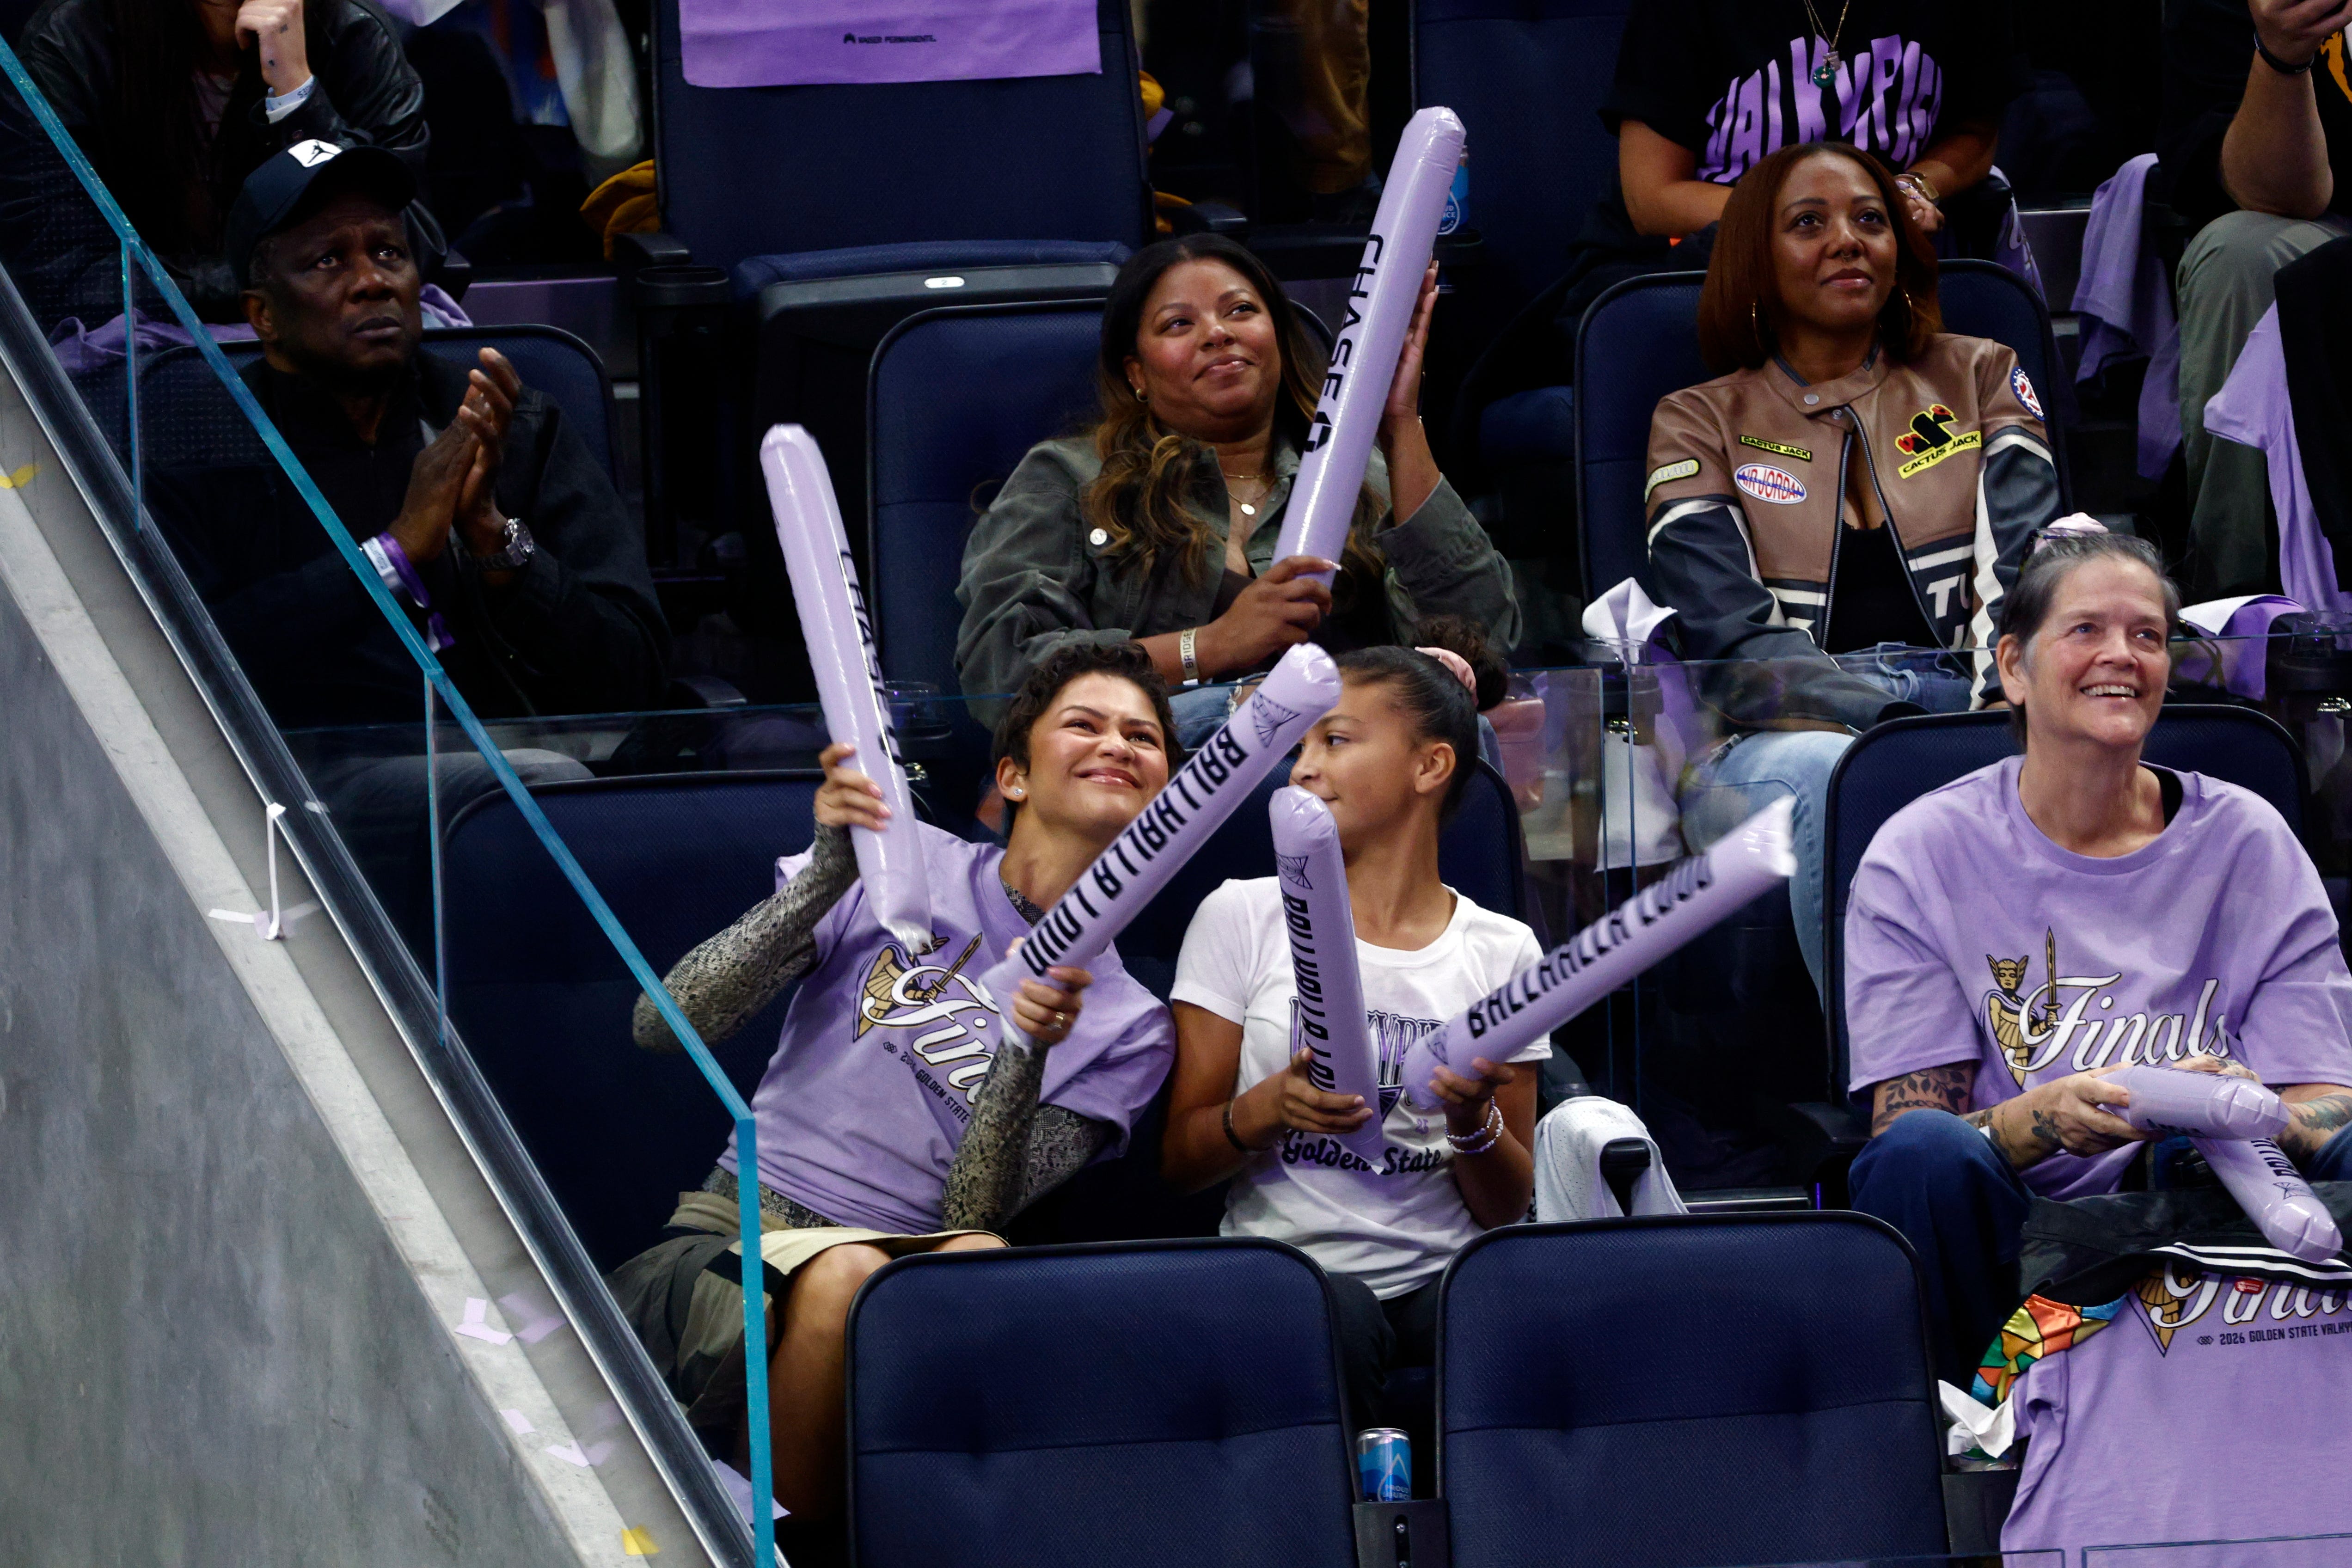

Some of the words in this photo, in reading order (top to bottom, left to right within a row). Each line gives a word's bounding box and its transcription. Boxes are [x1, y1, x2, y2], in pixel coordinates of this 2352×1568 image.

[1324, 233, 1384, 401] CHASE
[1743, 436, 1781, 451] CACTUS
[1783, 447, 1809, 458] JACK
[1903, 447, 1946, 473] CACTUS
[1949, 434, 1979, 451] JACK
[1182, 631, 1194, 669] BRIDGE
[1091, 724, 1250, 901] BALLHALLA
[2004, 972, 2230, 1072] Finals
[915, 1069, 947, 1098] GOLDEN
[945, 1096, 970, 1123] STATE
[1282, 1131, 1371, 1172] Golden
[1381, 1146, 1443, 1176] State
[2220, 1332, 2245, 1345] 2026
[2249, 1329, 2285, 1342] GOLDEN
[2288, 1325, 2318, 1339] STATE
[2321, 1321, 2352, 1335] VALKY
